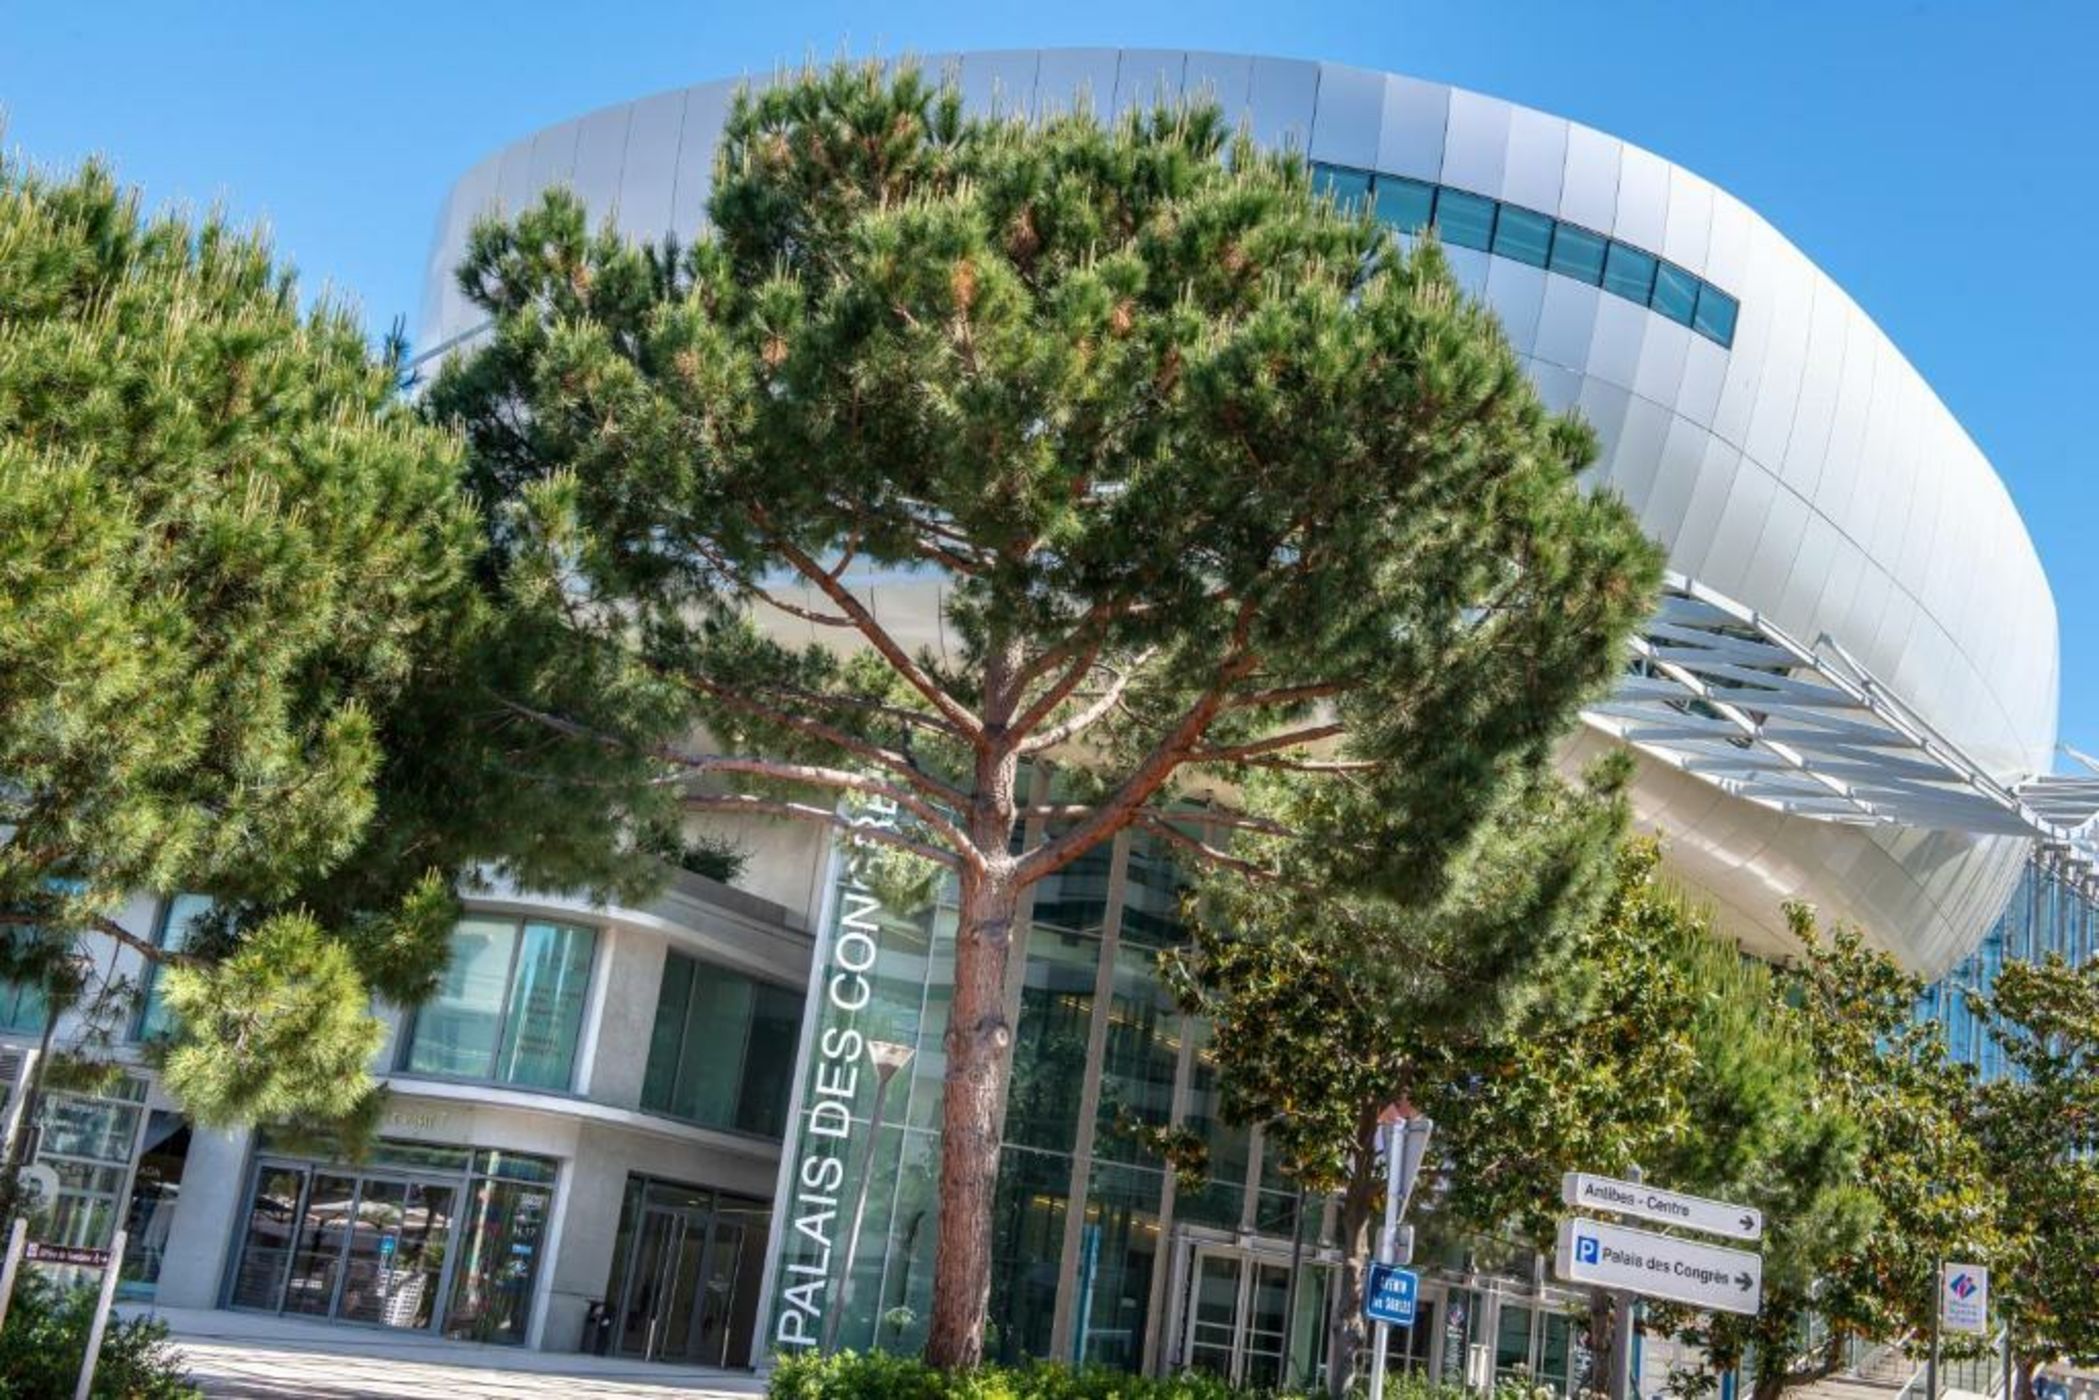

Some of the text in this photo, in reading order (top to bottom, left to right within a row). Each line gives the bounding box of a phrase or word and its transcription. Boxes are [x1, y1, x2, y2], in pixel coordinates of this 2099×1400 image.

[809, 1028, 862, 1138] DES
[1584, 1184, 1635, 1206] Antibes
[1647, 1196, 1690, 1217] Centre
[777, 1156, 843, 1346] PALAIS
[1602, 1246, 1643, 1269] Palais
[1646, 1257, 1671, 1274] des
[1674, 1262, 1729, 1286] Congrès
